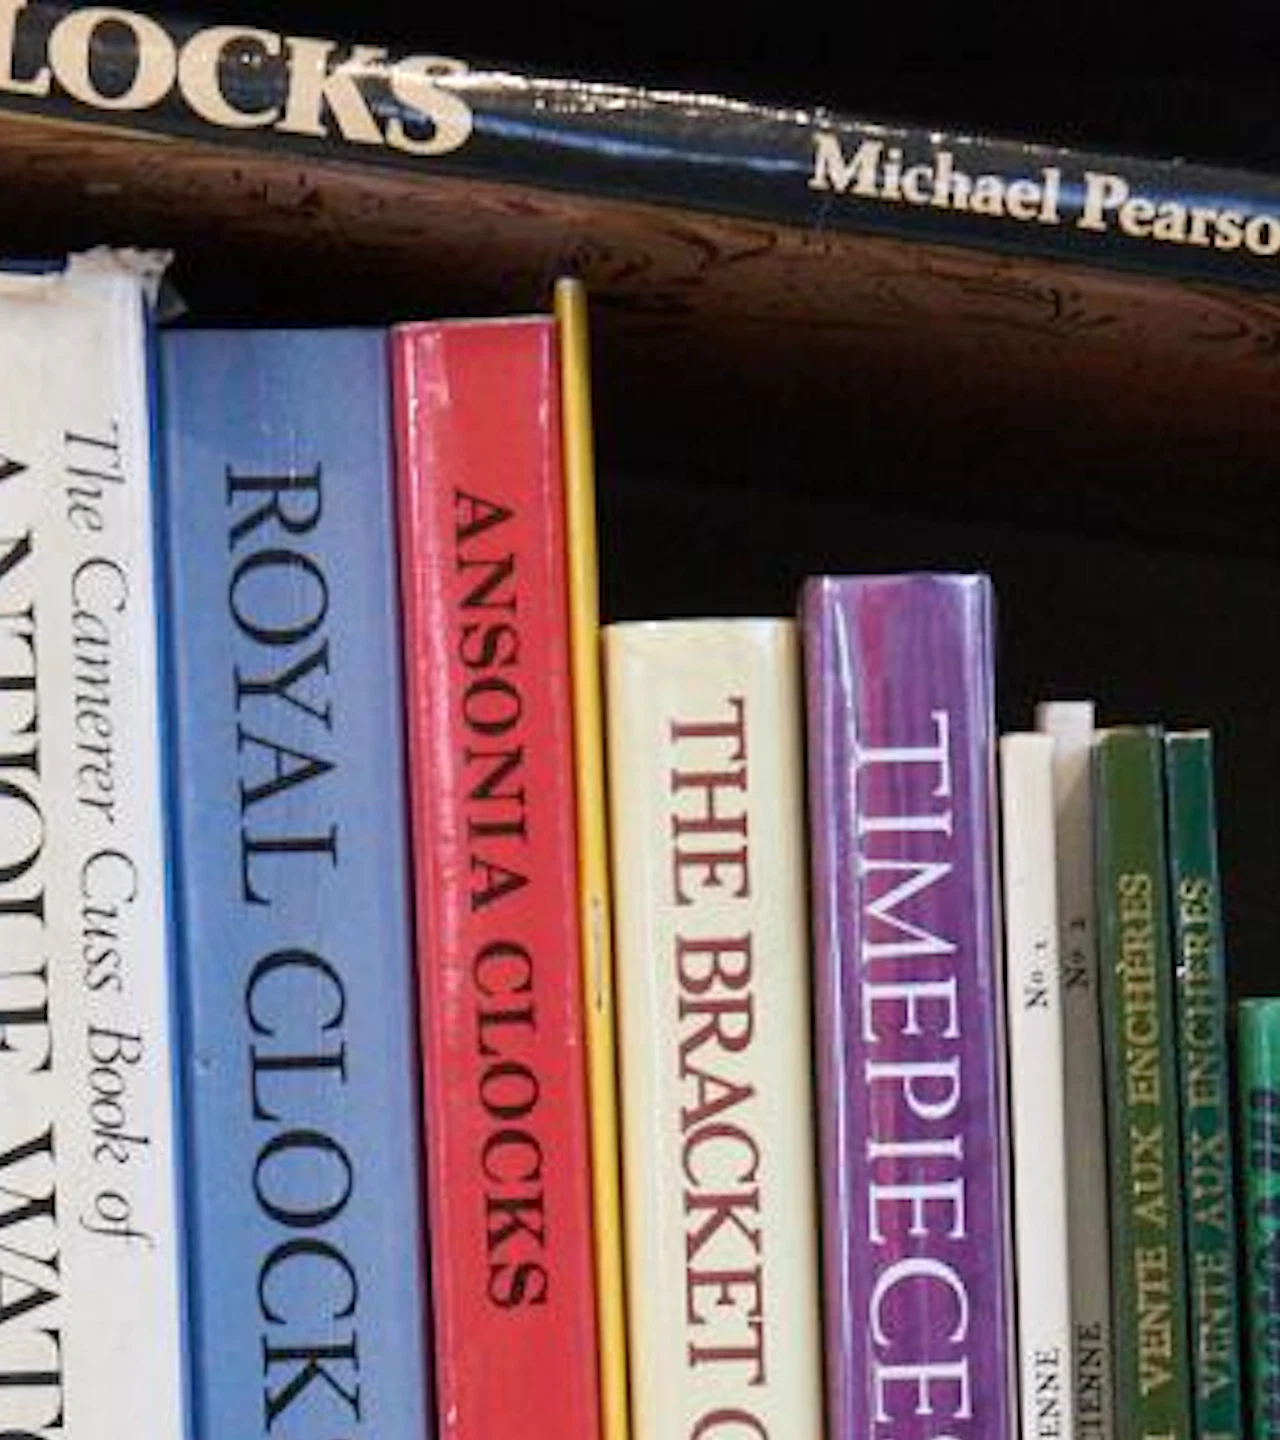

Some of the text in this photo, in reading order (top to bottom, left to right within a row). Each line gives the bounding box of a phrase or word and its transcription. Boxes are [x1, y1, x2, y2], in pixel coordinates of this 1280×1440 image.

[808, 132, 1061, 224] Michael
[225, 461, 339, 908] ROYAL
[65, 423, 156, 1250] The Camerer Cuss Book of
[670, 695, 750, 906] THE
[454, 488, 550, 1311] ANSONIA CLOCKS
[675, 932, 768, 1386] BRACKET
[1129, 1122, 1169, 1230] AUX
[1189, 1128, 1228, 1230] AUX
[1135, 1245, 1173, 1397] VENTE
[1197, 1252, 1233, 1399] VENTE
